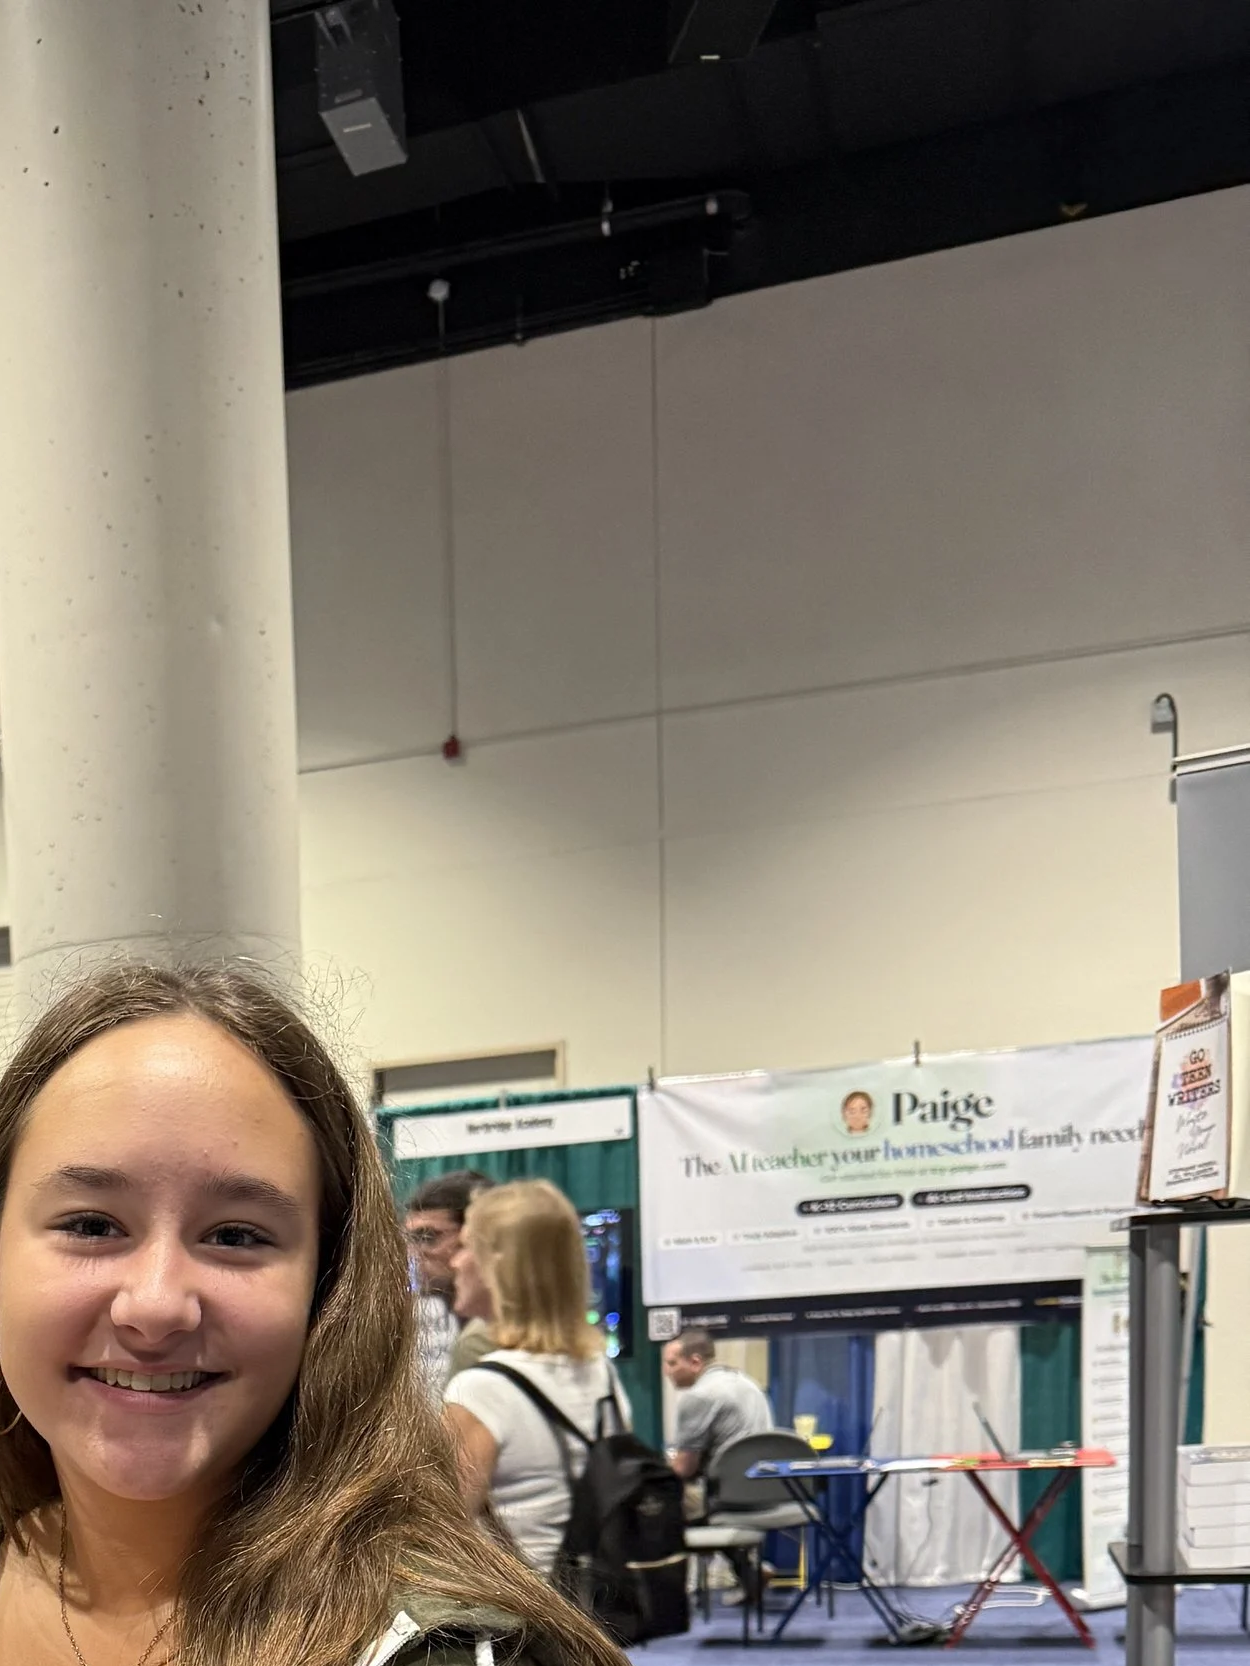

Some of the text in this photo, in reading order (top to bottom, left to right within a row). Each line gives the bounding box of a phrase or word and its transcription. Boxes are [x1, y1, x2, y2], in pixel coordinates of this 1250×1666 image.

[891, 1088, 996, 1130] Paige
[680, 1154, 721, 1179] The
[750, 1143, 829, 1173] teacher
[829, 1147, 882, 1174] your
[883, 1131, 1014, 1162] homeschool
[1017, 1126, 1082, 1152] family
[1089, 1121, 1146, 1147] need
